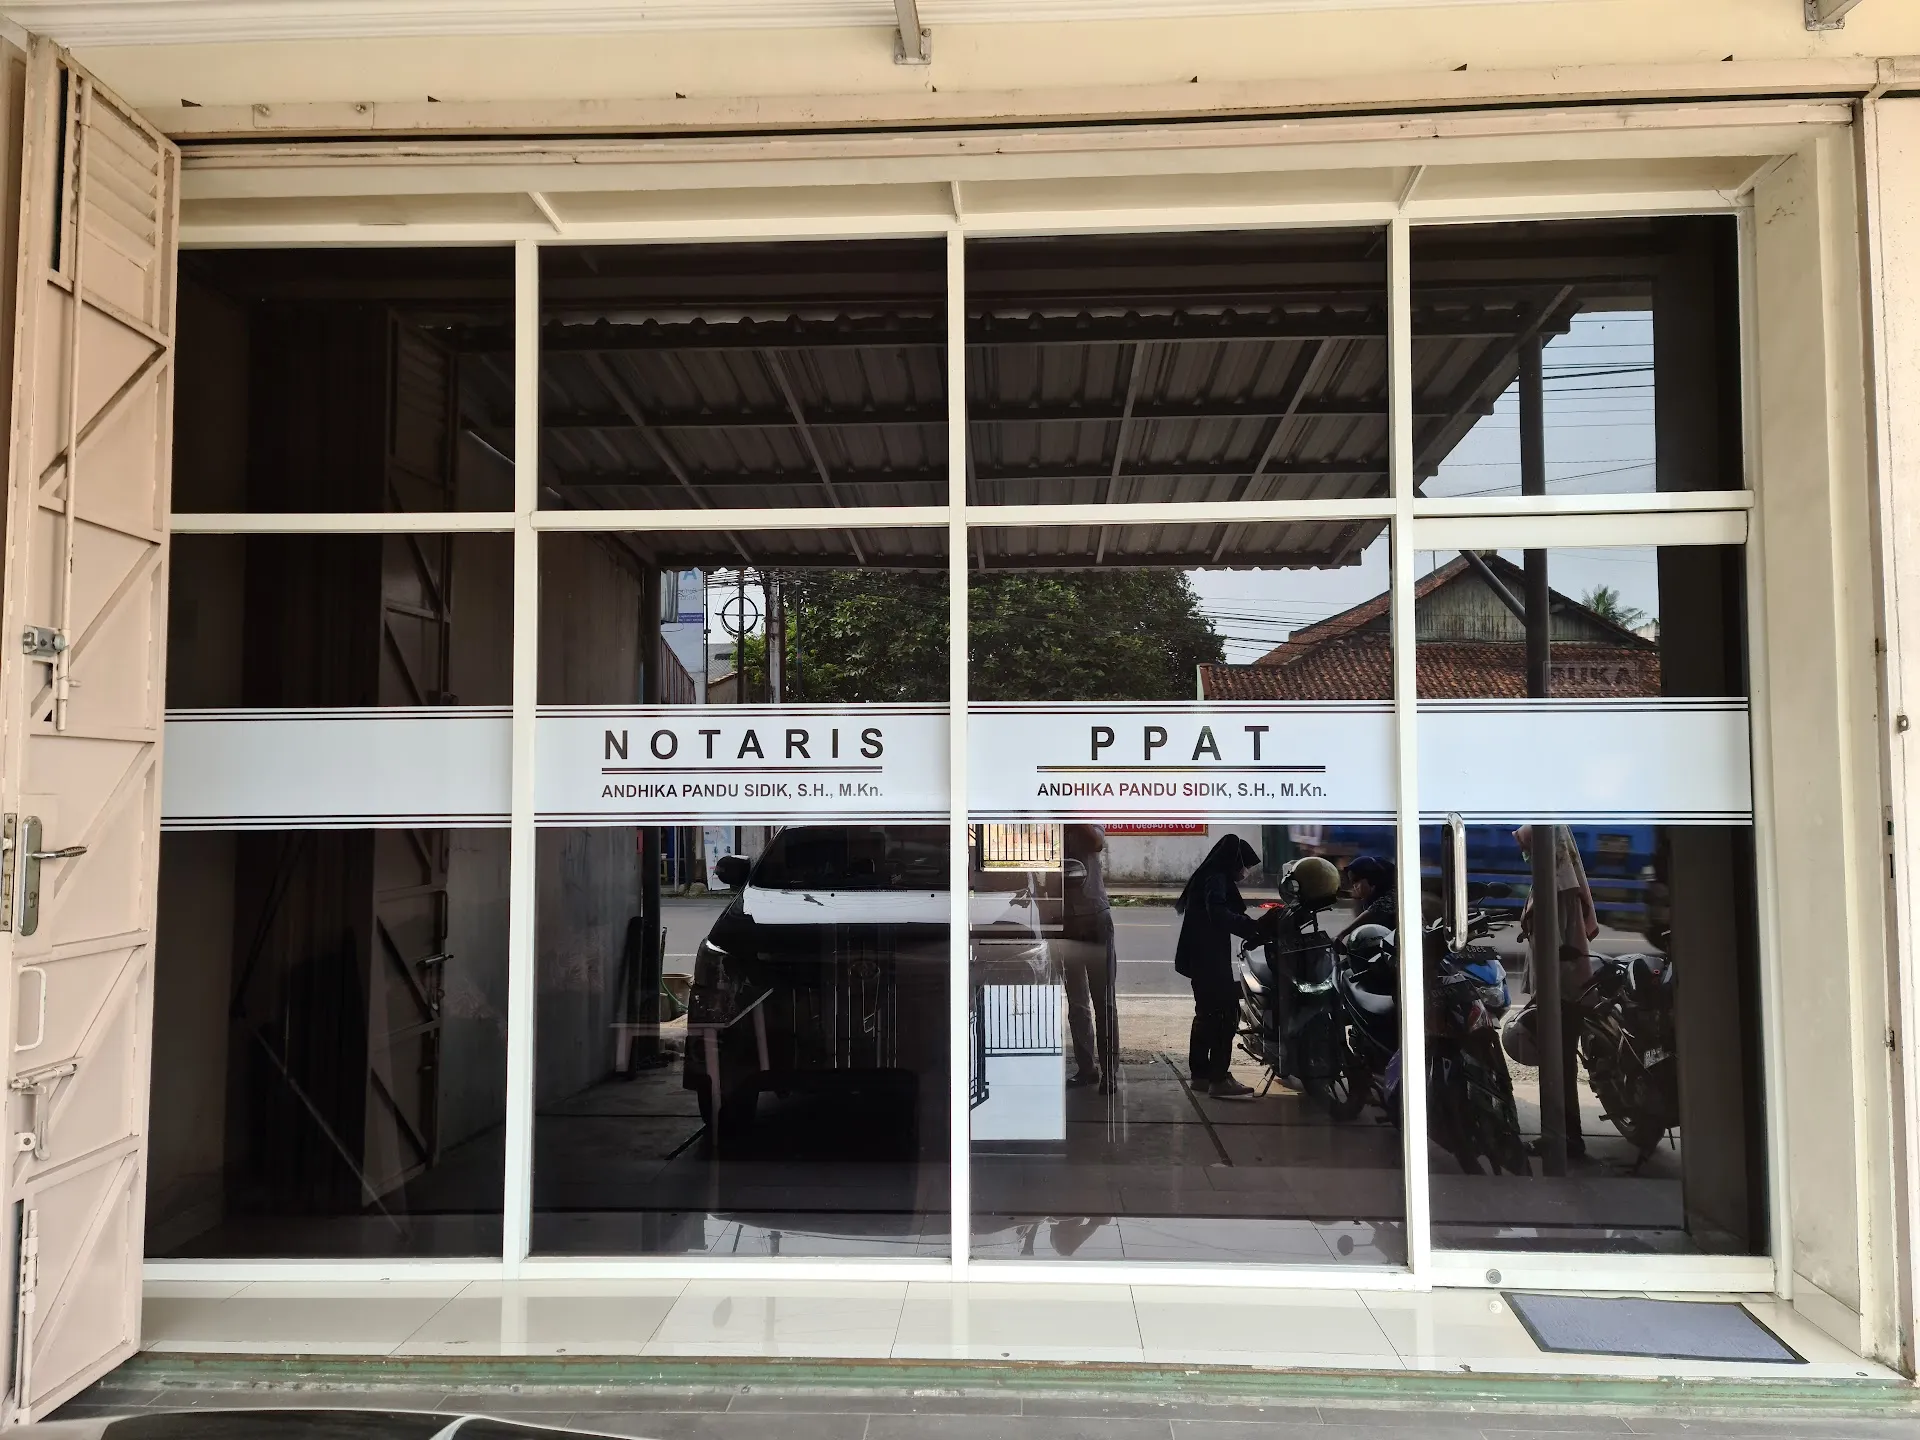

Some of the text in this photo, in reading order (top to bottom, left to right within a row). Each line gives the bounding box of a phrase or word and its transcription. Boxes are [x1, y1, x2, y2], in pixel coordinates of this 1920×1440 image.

[604, 727, 884, 760] NOTARIS
[1090, 725, 1270, 761] PPAT
[601, 782, 883, 800] ANDHIKA PANDU SIDIK, S.H., M.Kn.
[1036, 782, 1327, 799] ANDHIKA PANDU SIDIK, S.H., M.Kn.
